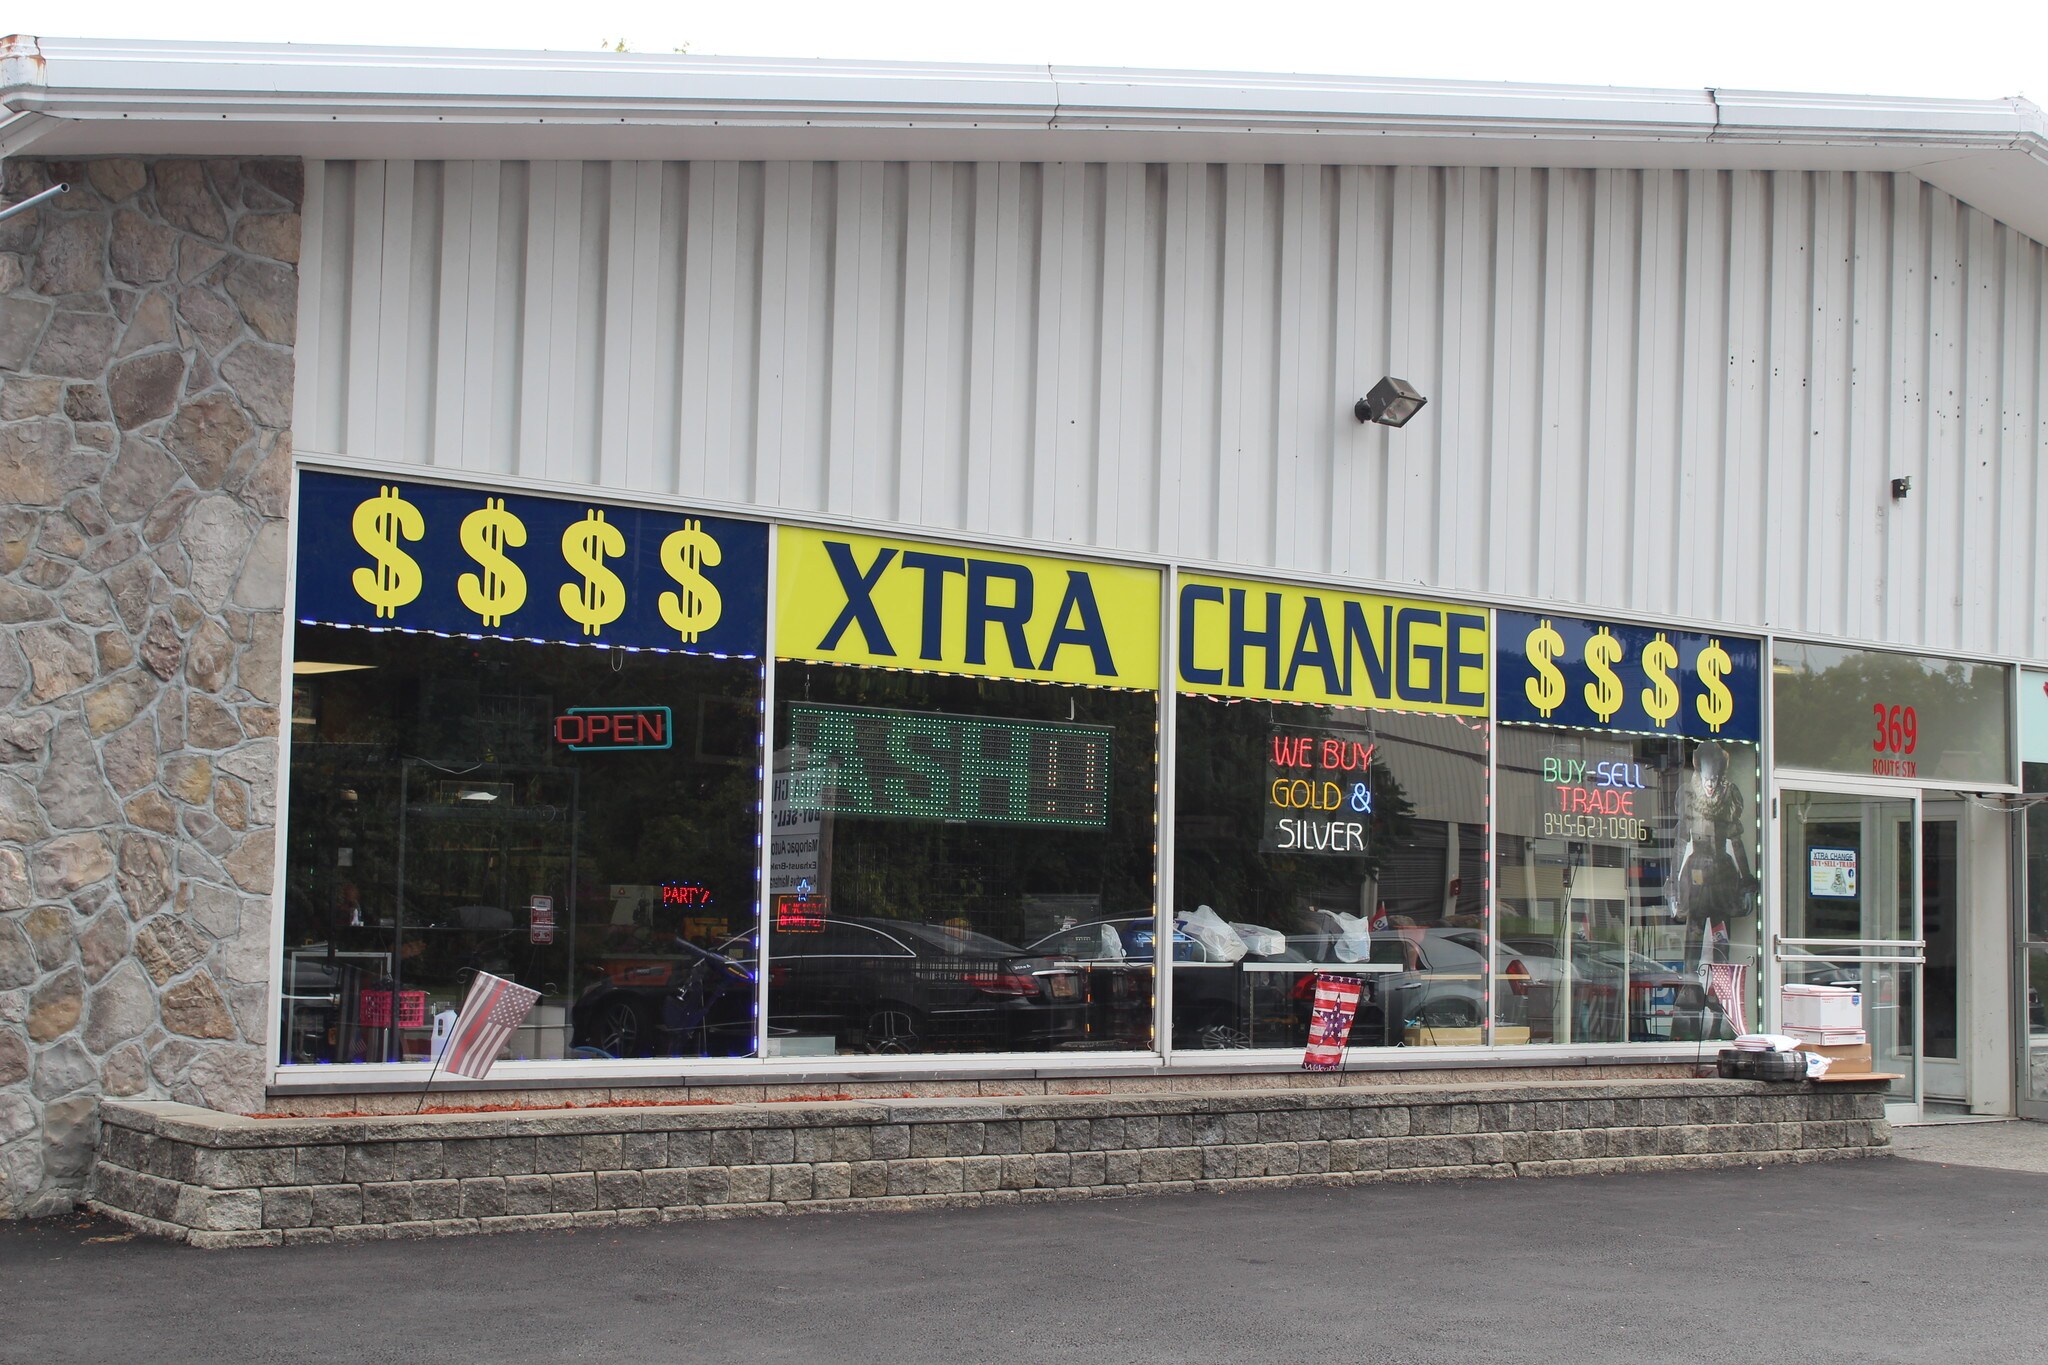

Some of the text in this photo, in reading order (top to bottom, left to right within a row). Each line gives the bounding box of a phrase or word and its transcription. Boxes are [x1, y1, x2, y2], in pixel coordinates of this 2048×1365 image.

[815, 540, 1486, 707] XTRA CHANGE
[556, 714, 662, 744] OPEN
[1873, 703, 1917, 754] 369
[1274, 736, 1374, 772] WE BUY
[1872, 759, 1917, 777] ROUTE SIX
[1272, 778, 1371, 813] GOLD &
[1556, 786, 1633, 816] TRADE
[1278, 819, 1364, 851] SILVER
[1544, 813, 1647, 841] 845-621-0906
[1813, 852, 1853, 861] XTRA CHANGE
